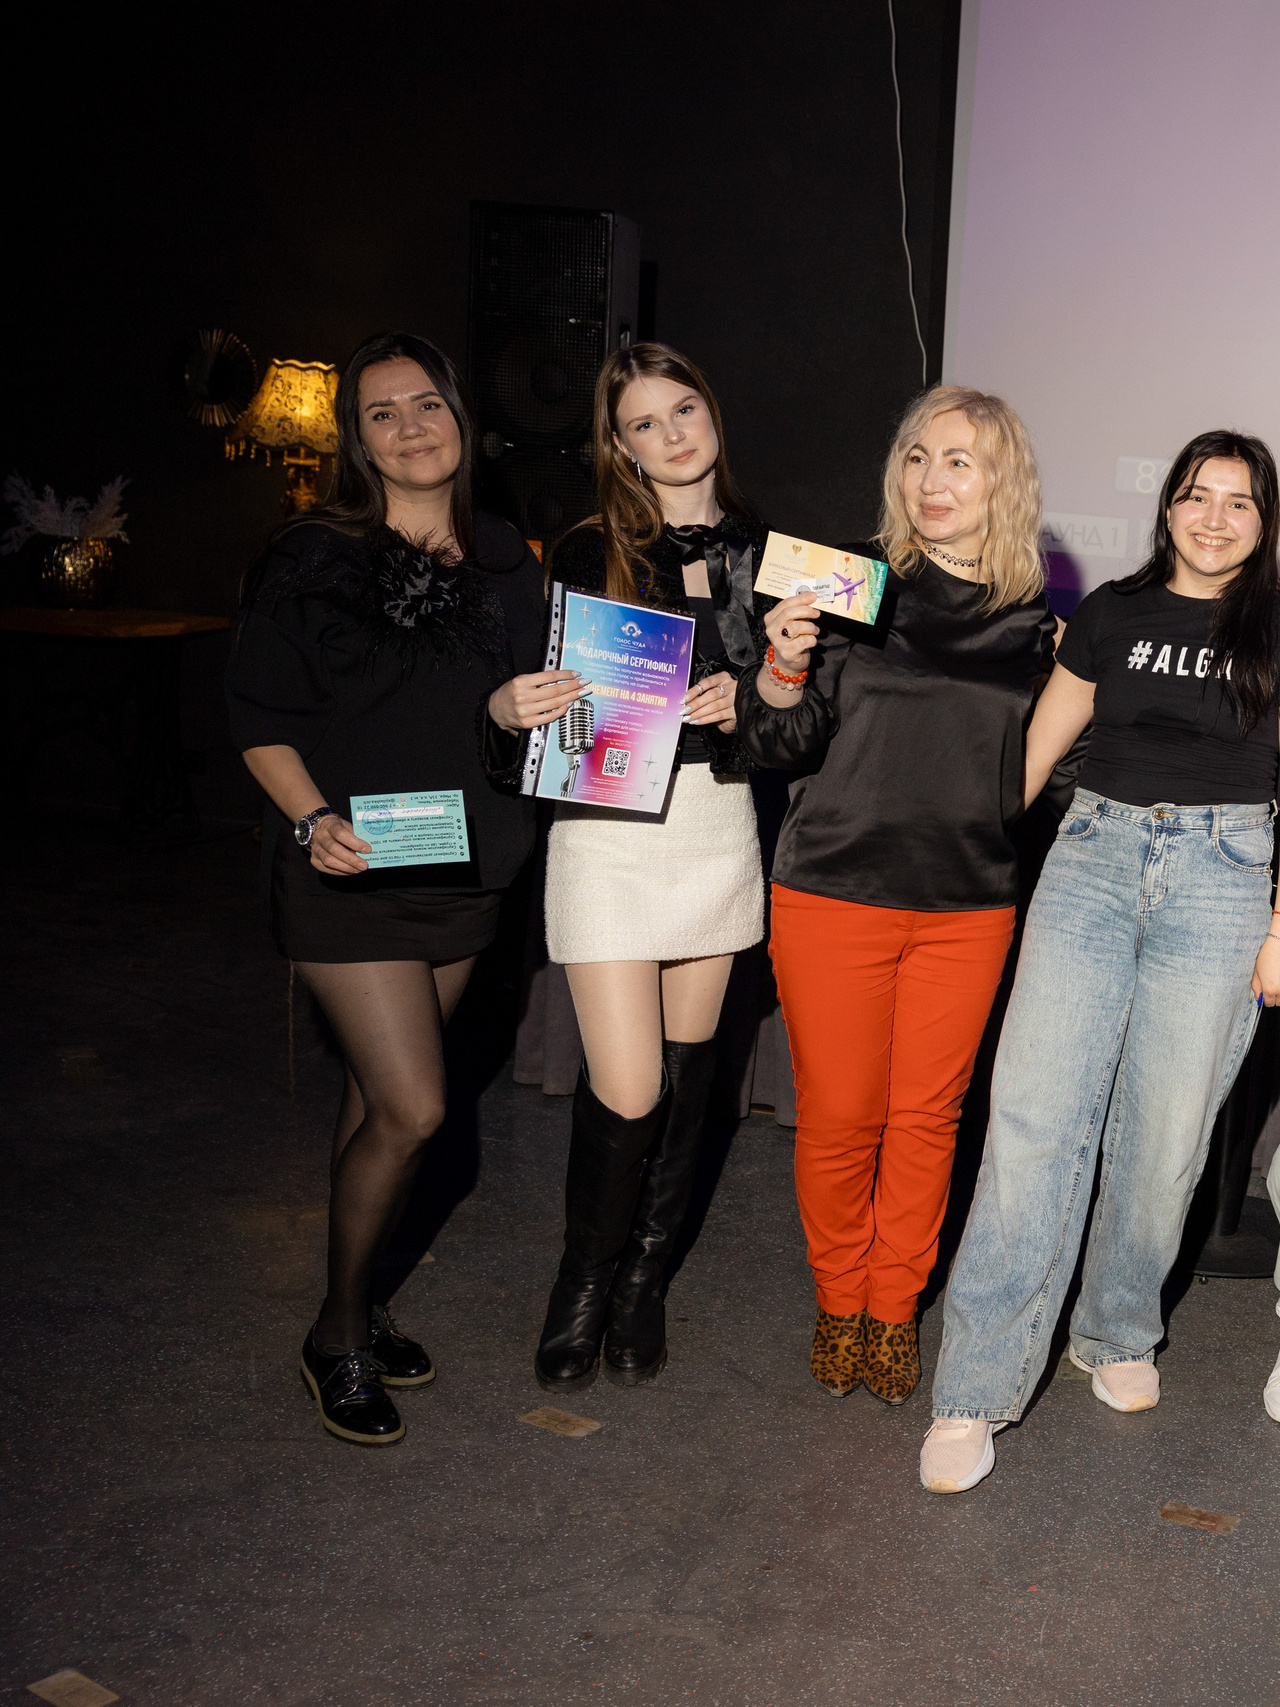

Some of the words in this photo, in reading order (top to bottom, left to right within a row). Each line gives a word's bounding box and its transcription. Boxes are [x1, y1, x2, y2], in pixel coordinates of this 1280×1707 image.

[613, 636, 631, 644] ГОЛОС
[632, 640, 646, 648] ЧУДА
[577, 646, 629, 663] ПОДАРОЧНЫЙ
[629, 655, 677, 675] СЕРТИФИКАТ
[619, 688, 630, 700] НА
[629, 690, 636, 701] 4
[636, 692, 667, 707] ЗАНЯТИЯ
